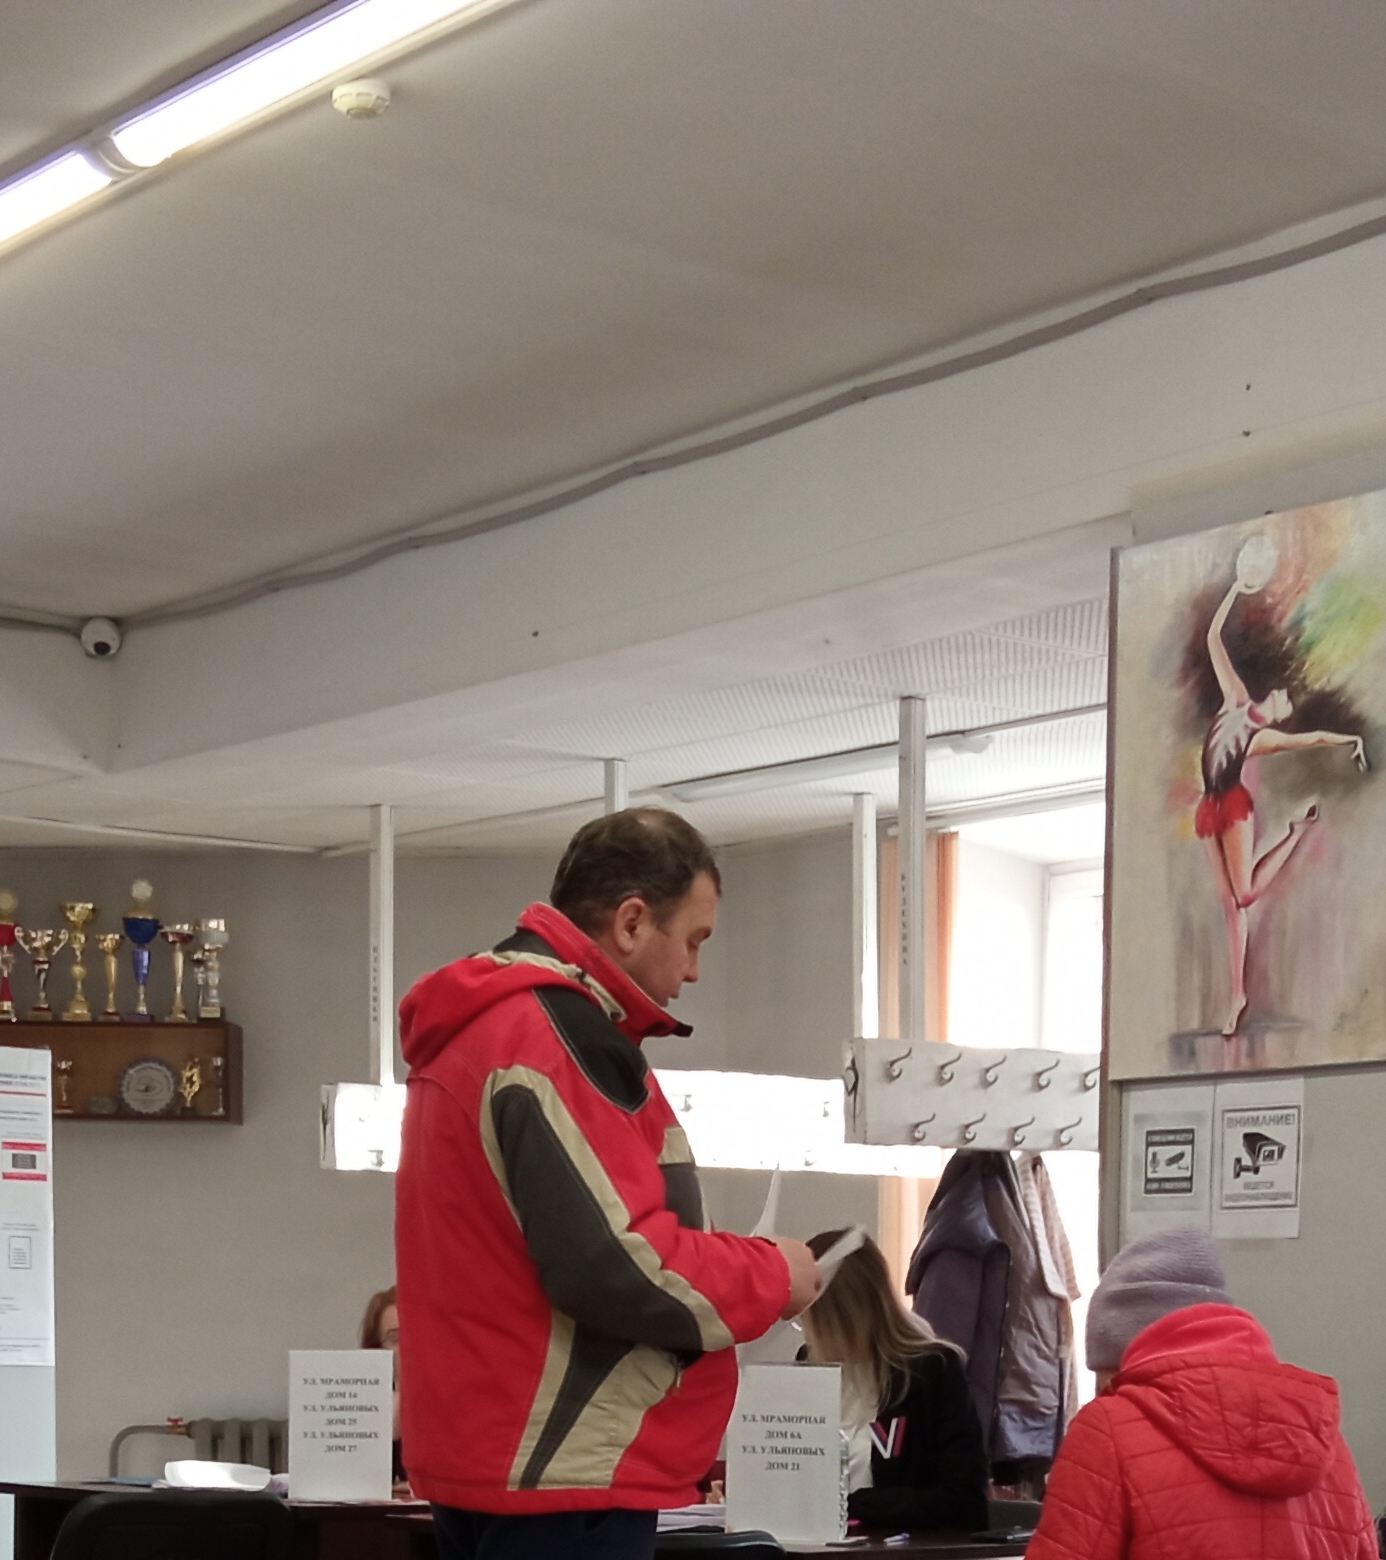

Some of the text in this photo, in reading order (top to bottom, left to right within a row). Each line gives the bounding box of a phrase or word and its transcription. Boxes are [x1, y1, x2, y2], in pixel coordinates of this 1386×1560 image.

[1226, 1113, 1296, 1129] ВНИМАНИЕ!
[320, 1378, 380, 1386] МРАМОРНАЯ
[325, 1418, 346, 1426] ДОМ
[760, 1414, 826, 1425] МРАМОРНАЯ
[764, 1431, 802, 1440] ДОМ 6А
[325, 1445, 346, 1453] ДОМ
[761, 1446, 826, 1456] УЛЬЯНОВЫХ
[765, 1462, 800, 1471] ДОМ 21
